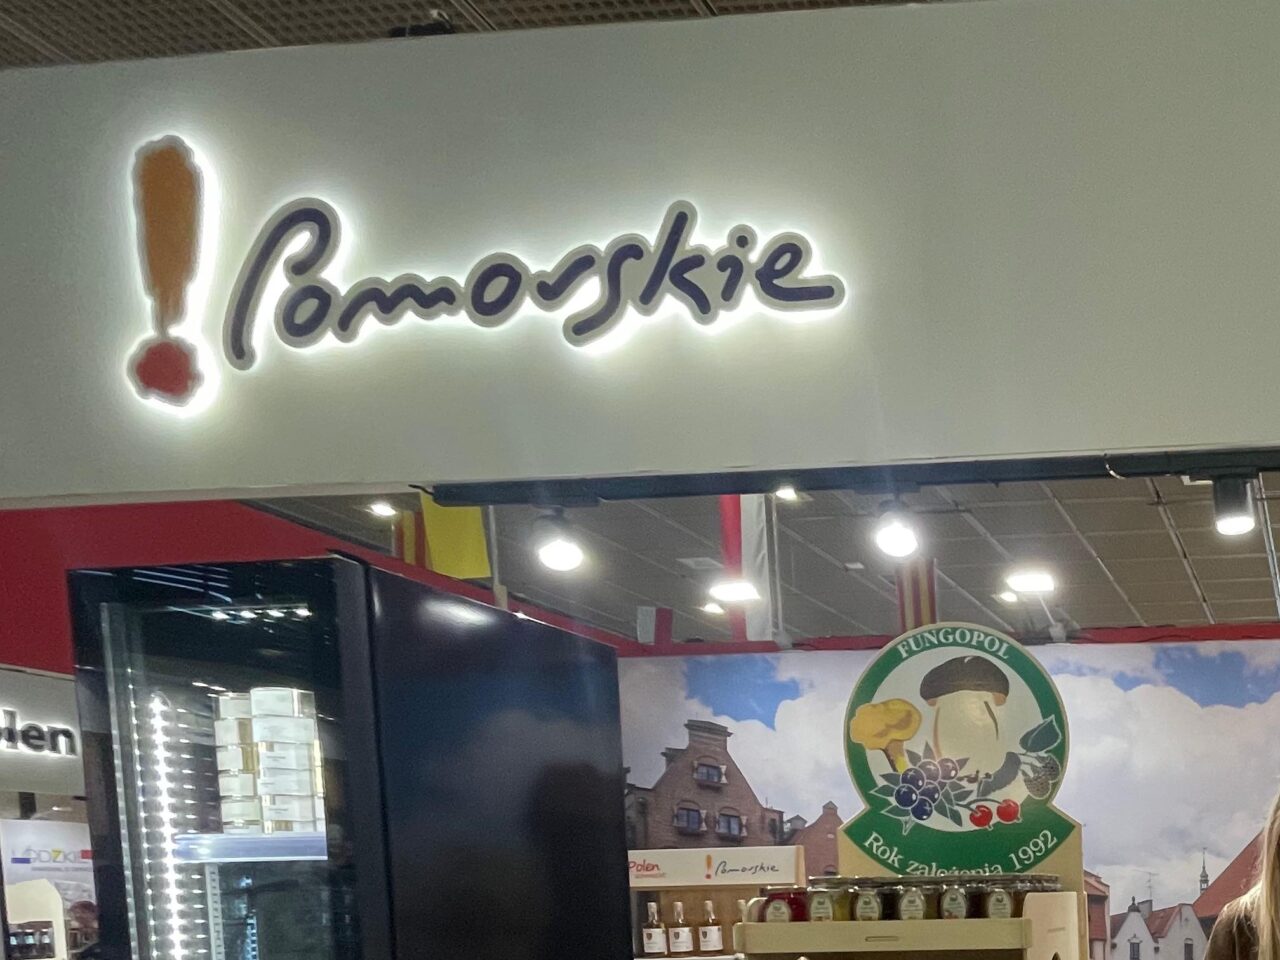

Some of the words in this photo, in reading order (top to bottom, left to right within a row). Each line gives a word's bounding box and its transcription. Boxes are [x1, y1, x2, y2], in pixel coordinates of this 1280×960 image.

[224, 197, 844, 370] Pomorskie
[896, 628, 1011, 660] FUNGOPOL
[0, 708, 78, 756] len
[715, 861, 779, 876] Pomorskie
[863, 831, 904, 868] Rok
[1008, 829, 1057, 871] 1992
